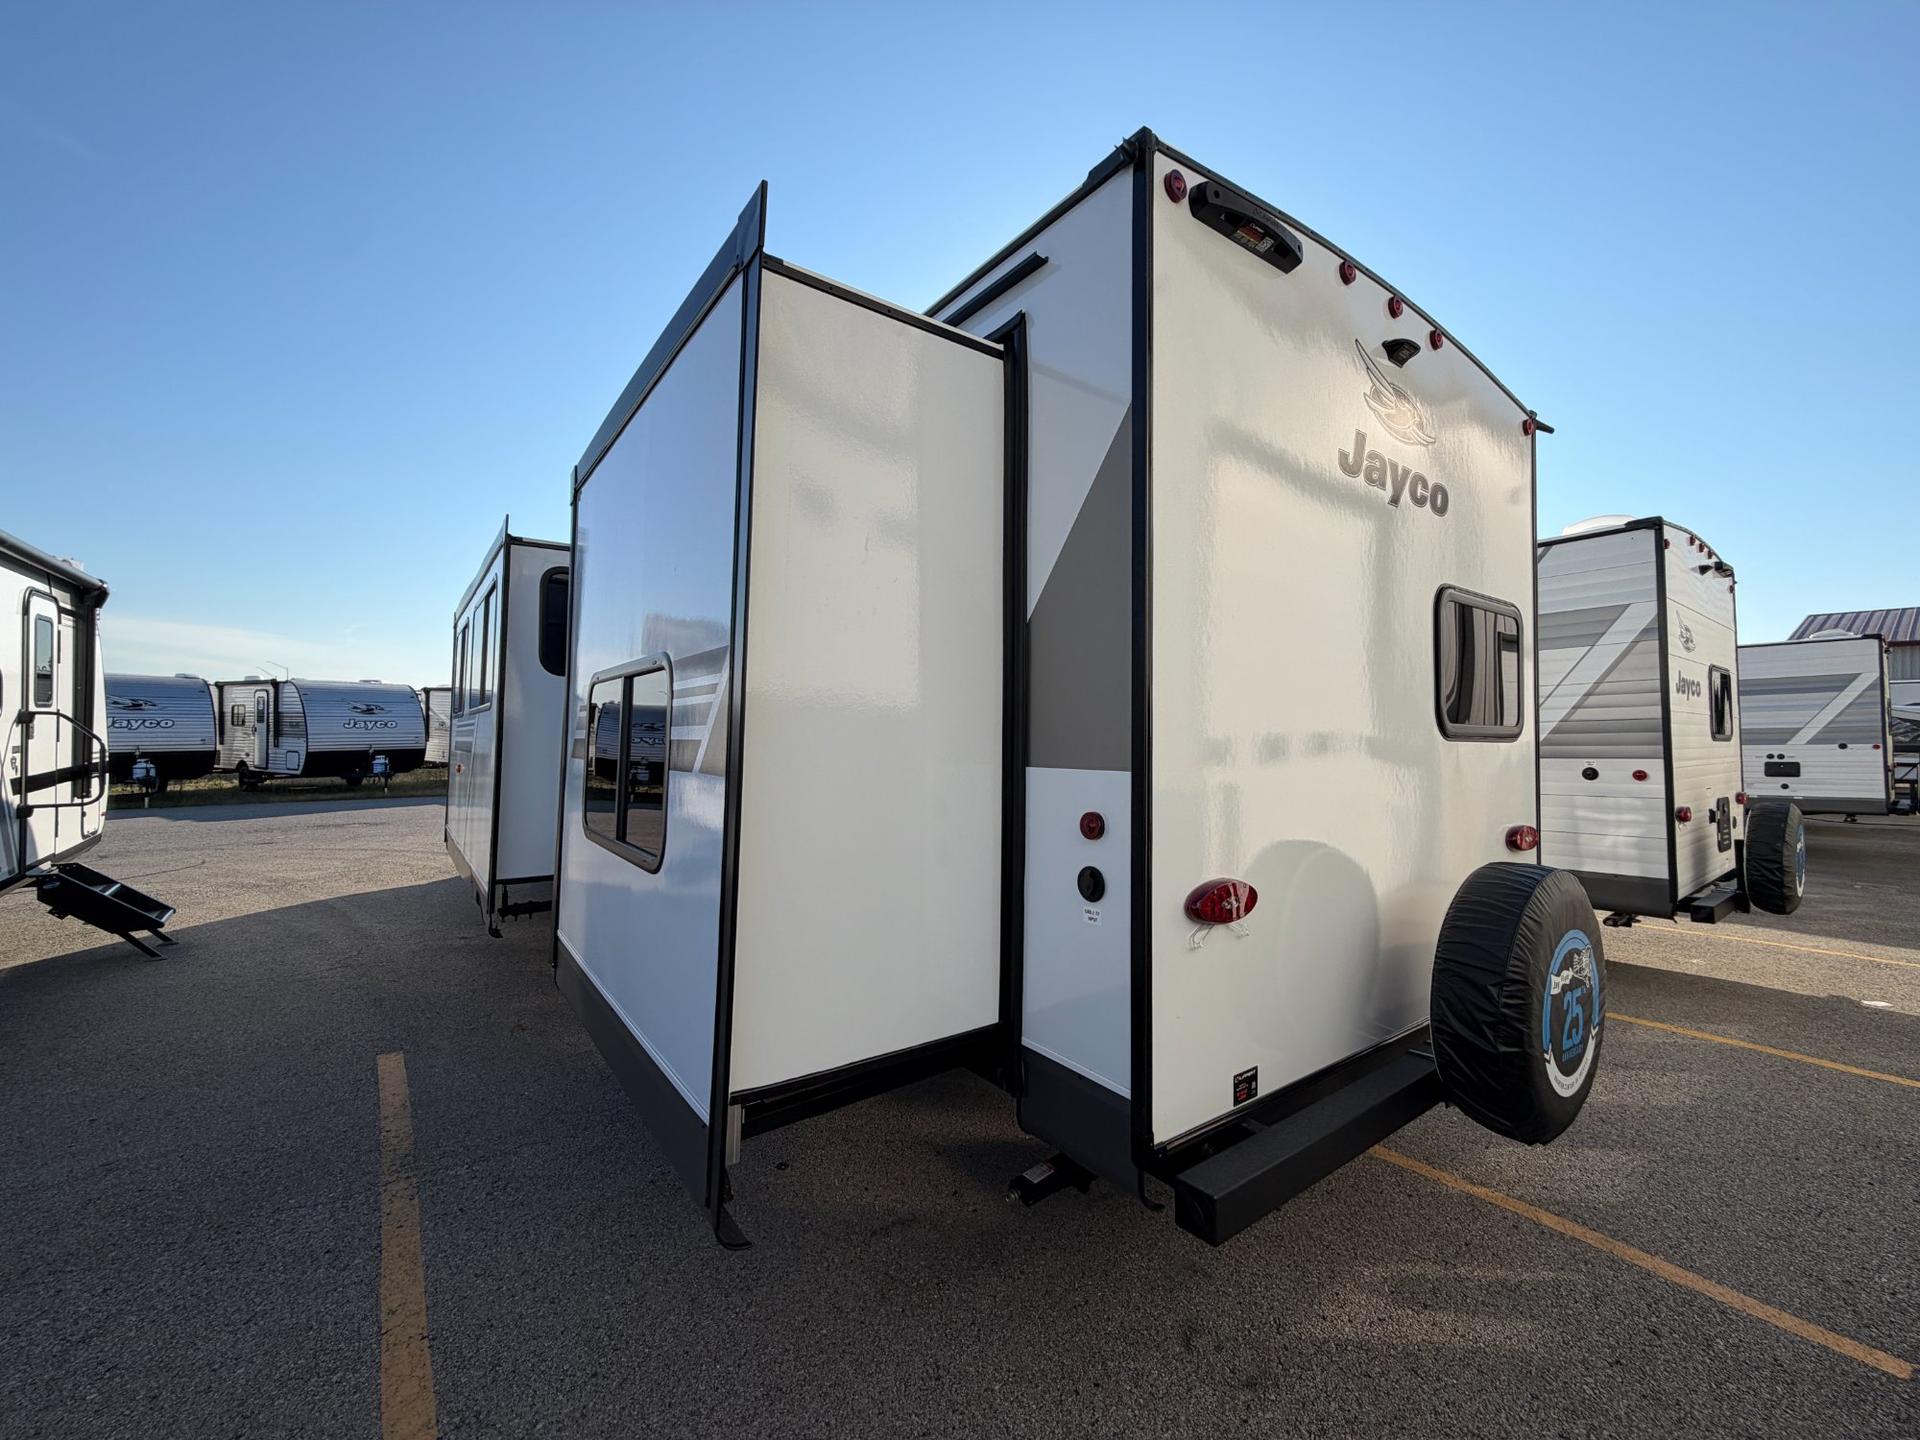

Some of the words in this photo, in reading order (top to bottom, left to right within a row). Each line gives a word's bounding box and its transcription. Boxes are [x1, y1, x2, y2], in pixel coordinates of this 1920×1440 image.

[1337, 428, 1449, 518] Jayco
[1675, 669, 1701, 701] Jayco
[343, 718, 399, 731] Jayco
[1563, 987, 1584, 1051] 25
